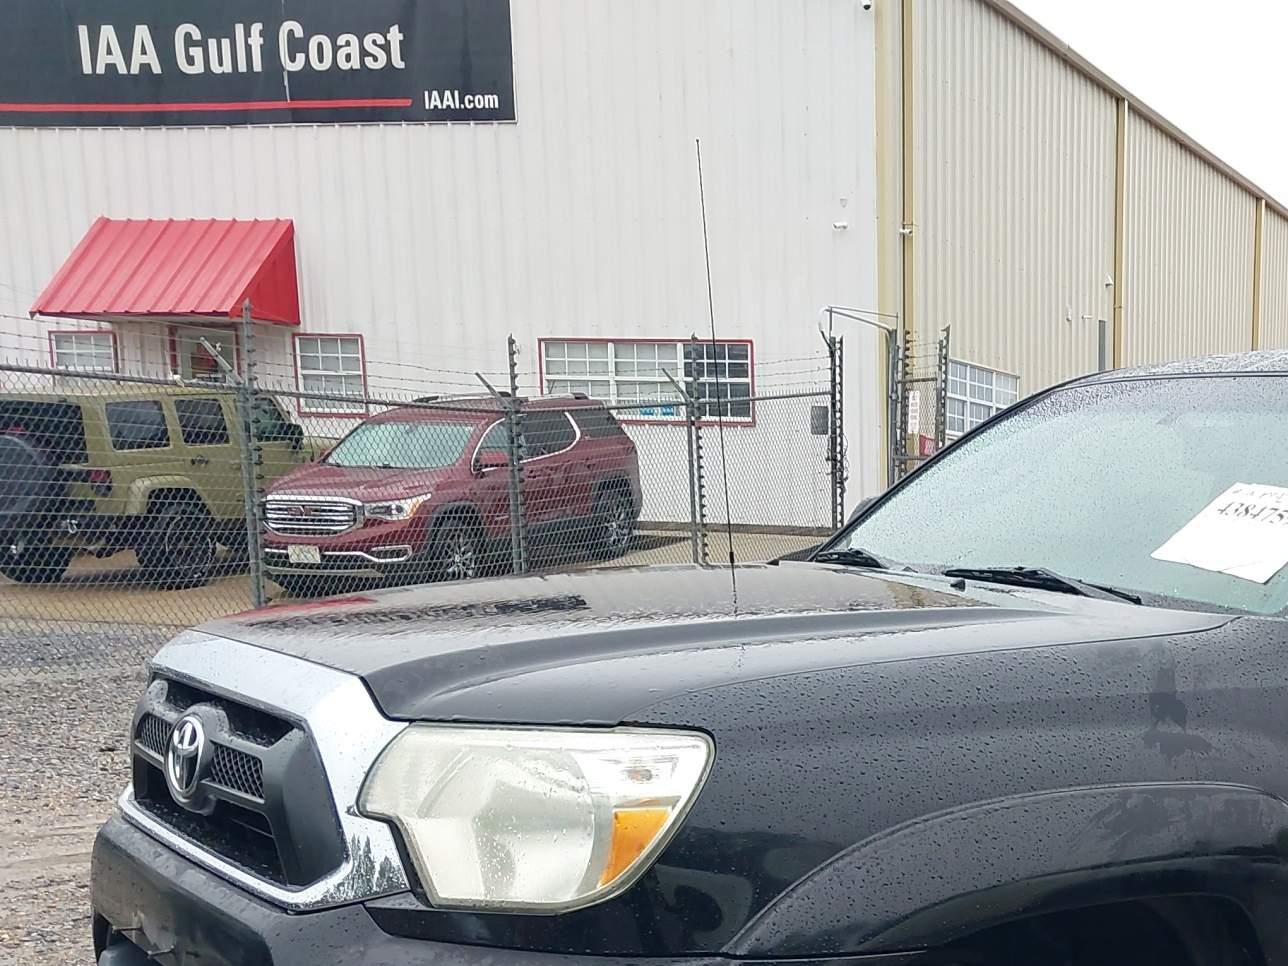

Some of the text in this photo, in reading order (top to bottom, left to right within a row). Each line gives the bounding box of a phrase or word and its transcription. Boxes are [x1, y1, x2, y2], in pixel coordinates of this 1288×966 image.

[78, 20, 405, 75] IAA Gulf Coast
[423, 90, 499, 110] IAAI.com
